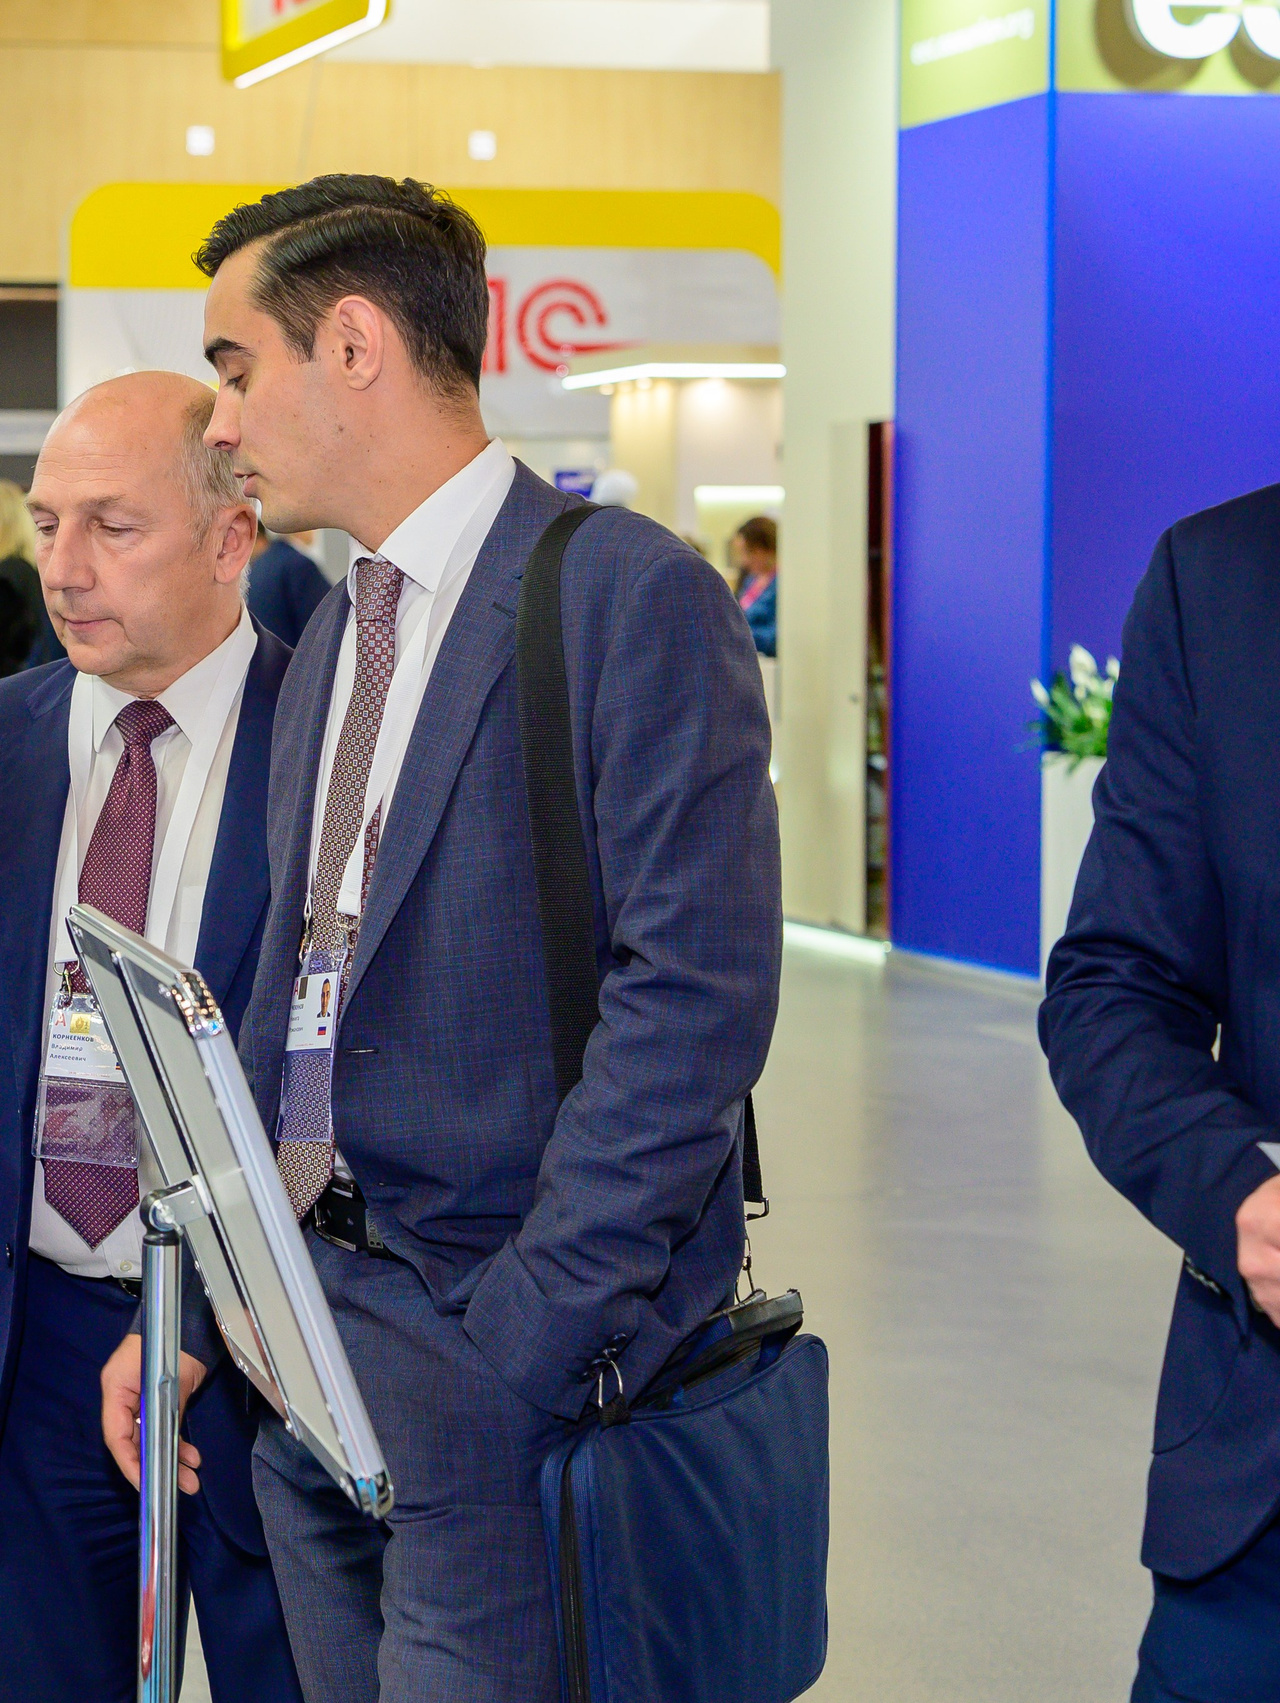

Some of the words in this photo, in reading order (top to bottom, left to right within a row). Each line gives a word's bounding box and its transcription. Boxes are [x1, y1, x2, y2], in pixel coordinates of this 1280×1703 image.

[52, 1034, 94, 1042] КОРНЕЕНКОВ
[51, 1043, 83, 1051] Владимир
[50, 1053, 86, 1061] Алексеевич
